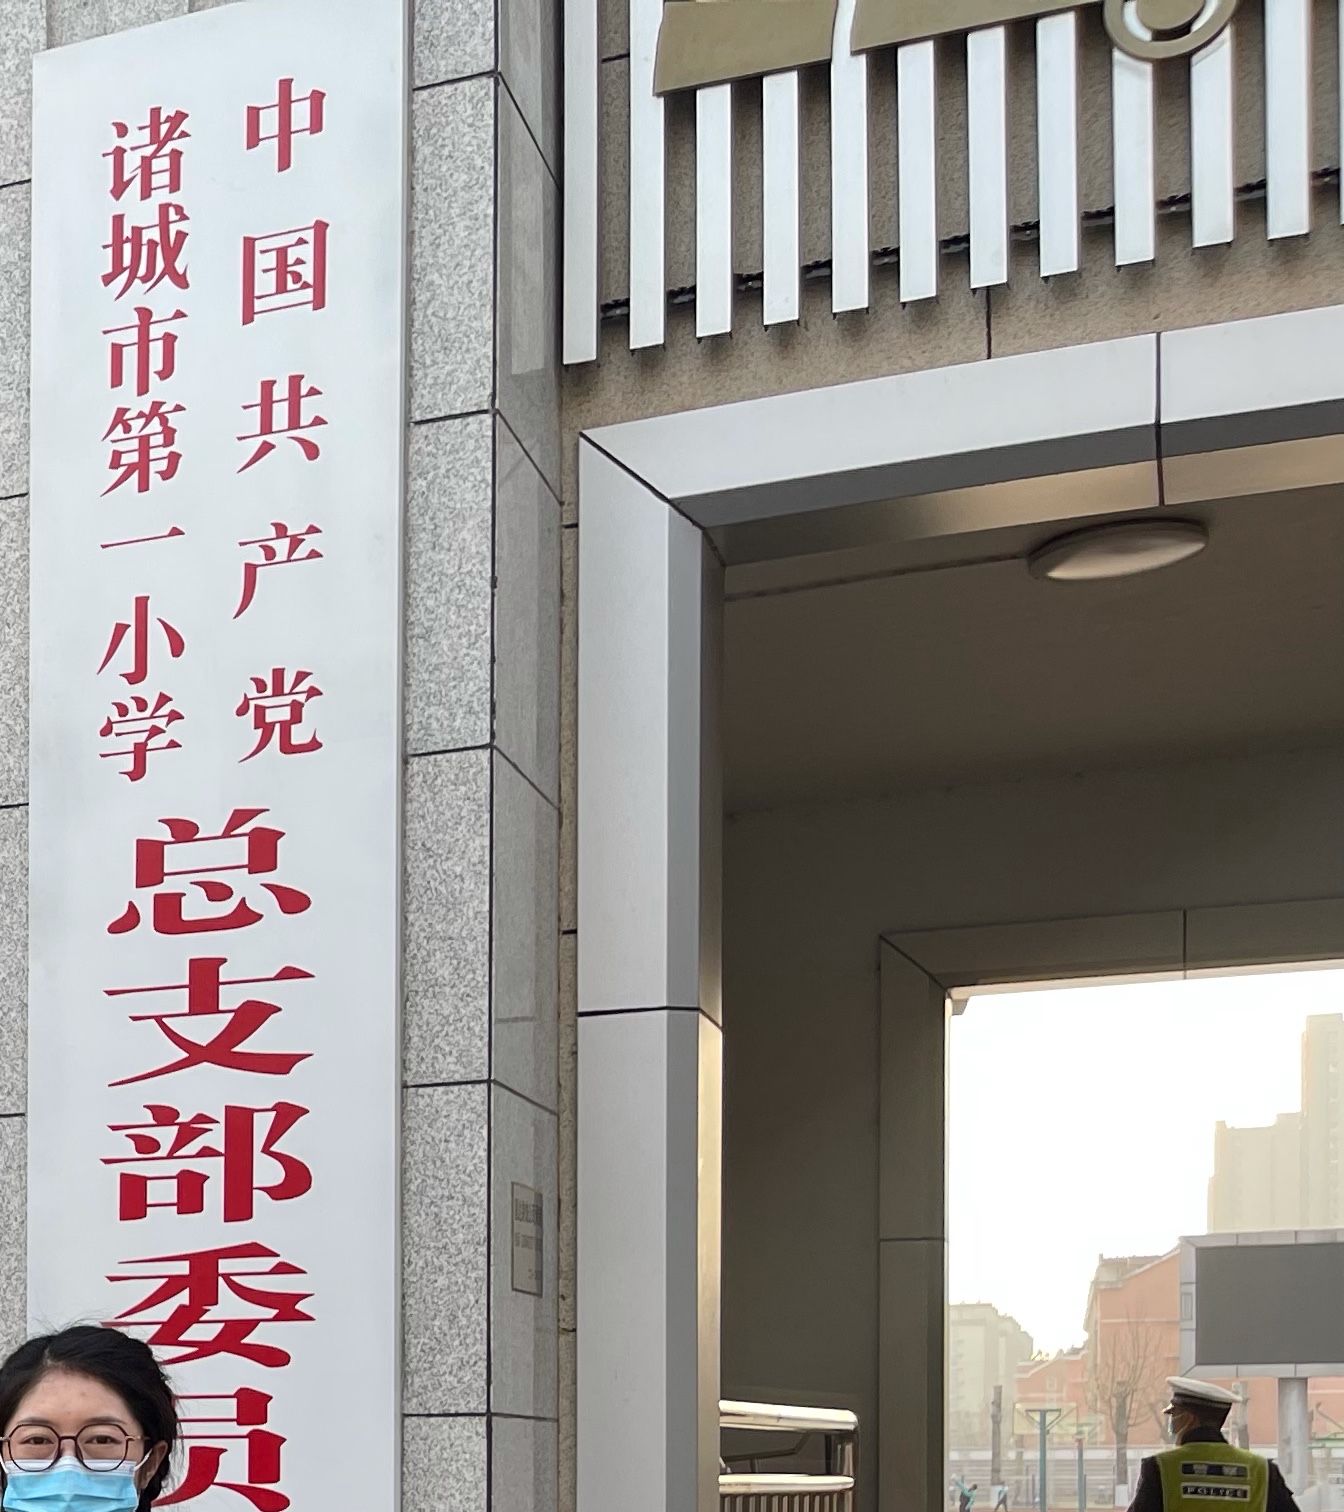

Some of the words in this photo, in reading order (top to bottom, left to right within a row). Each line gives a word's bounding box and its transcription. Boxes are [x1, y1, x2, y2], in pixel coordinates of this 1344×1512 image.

[96, 105, 192, 783] 诸城市第一小学
[233, 77, 330, 764] 中国共产党
